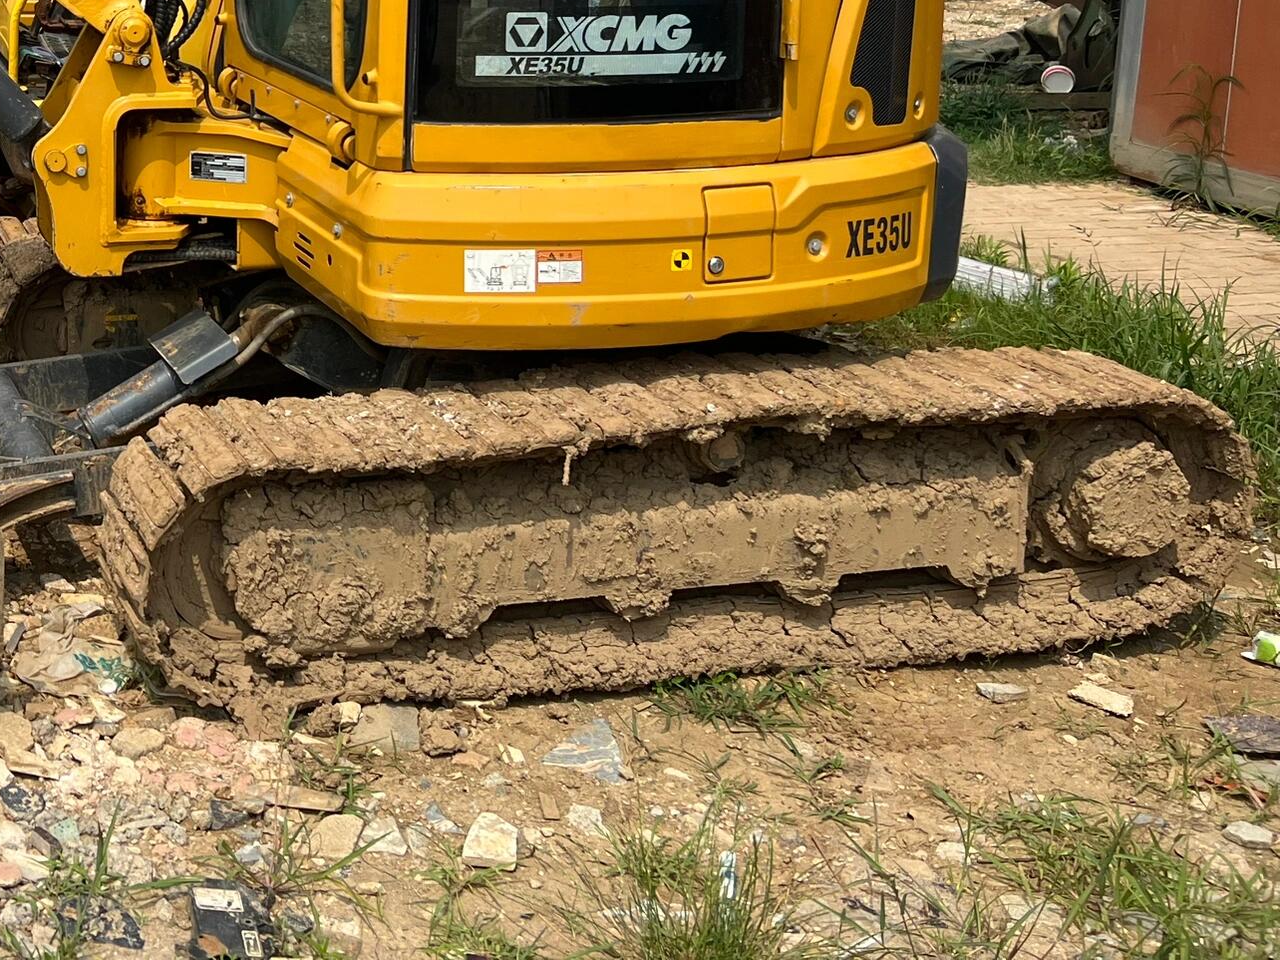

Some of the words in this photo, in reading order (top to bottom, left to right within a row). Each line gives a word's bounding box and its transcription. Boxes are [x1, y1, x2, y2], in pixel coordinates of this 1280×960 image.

[547, 13, 692, 53] XCMG
[506, 56, 585, 75] XE35U
[845, 211, 912, 258] XE35U
